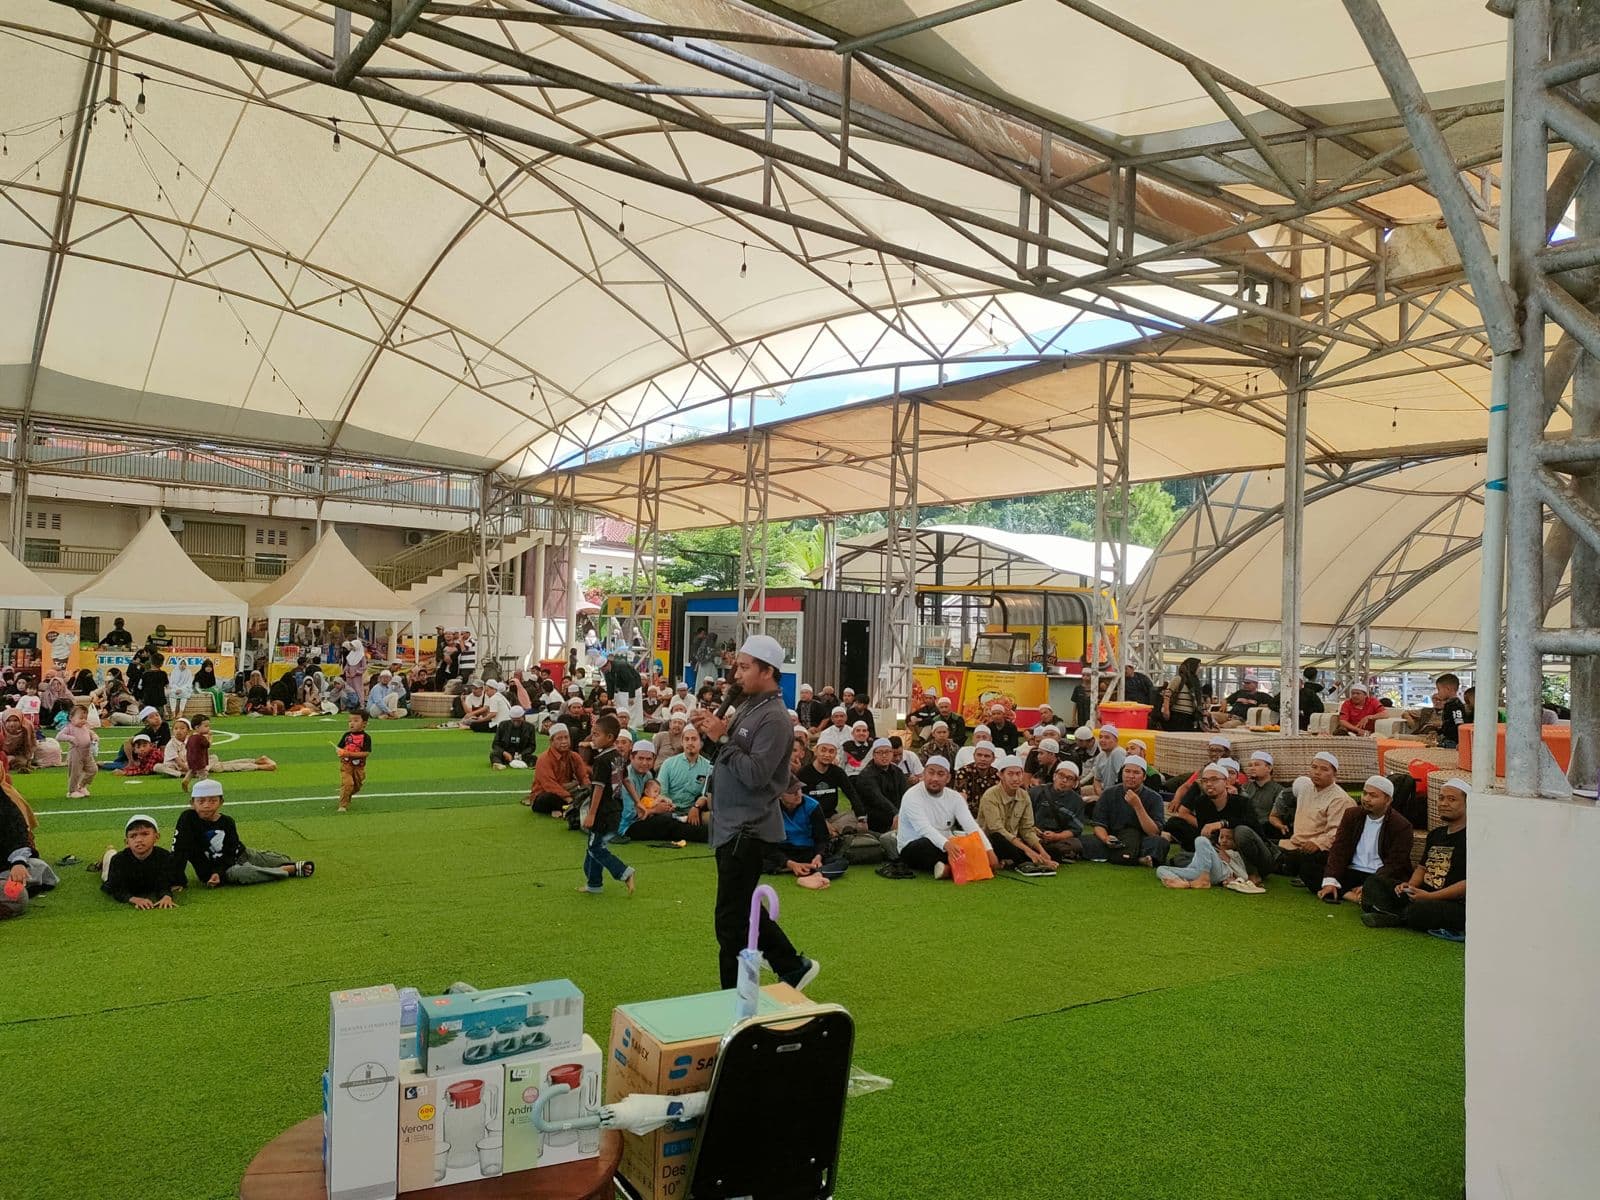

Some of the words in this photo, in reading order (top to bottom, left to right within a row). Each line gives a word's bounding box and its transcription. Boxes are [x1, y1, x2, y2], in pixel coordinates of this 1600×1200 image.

[98, 656, 132, 665] TERS
[508, 1104, 533, 1115] Andri
[401, 1123, 434, 1134] Verona
[662, 1164, 687, 1178] Des
